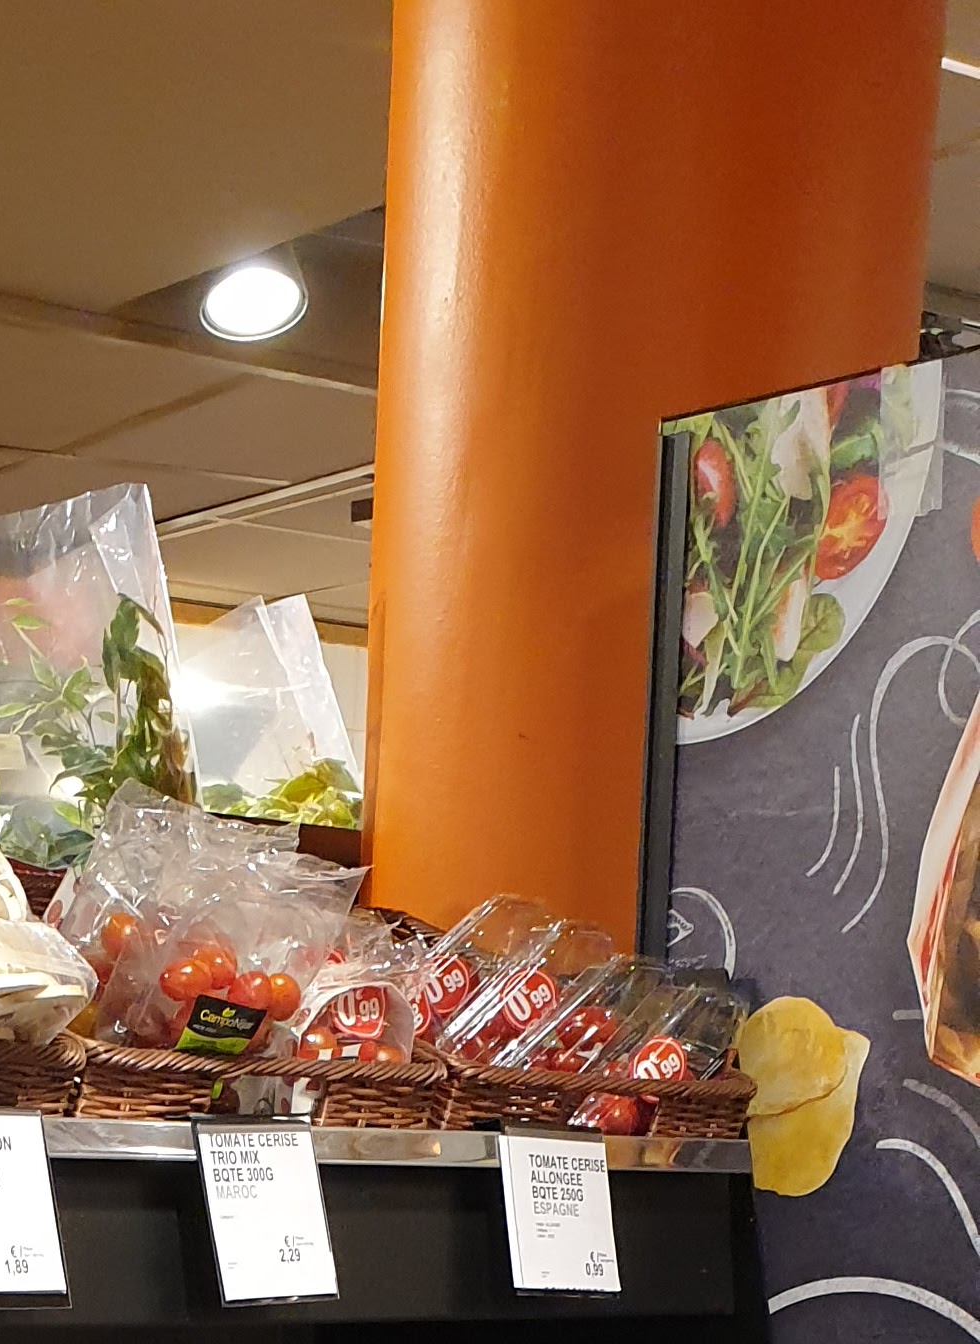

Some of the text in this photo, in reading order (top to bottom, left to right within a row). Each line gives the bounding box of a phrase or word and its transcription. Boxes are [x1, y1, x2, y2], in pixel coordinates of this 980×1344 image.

[208, 1132, 299, 1149] TOMATE CERISE
[210, 1150, 261, 1166] TRIO MIX
[528, 1153, 606, 1174] TOMATE CERISE
[212, 1166, 274, 1183] BQTE 300G
[530, 1169, 583, 1187] ALLONGEE
[215, 1184, 258, 1200] MAROC
[532, 1185, 584, 1203] BQTE 250G
[533, 1201, 580, 1218] ESPAGNE
[279, 1248, 301, 1264] 2,29
[4, 1258, 29, 1276] 1,89
